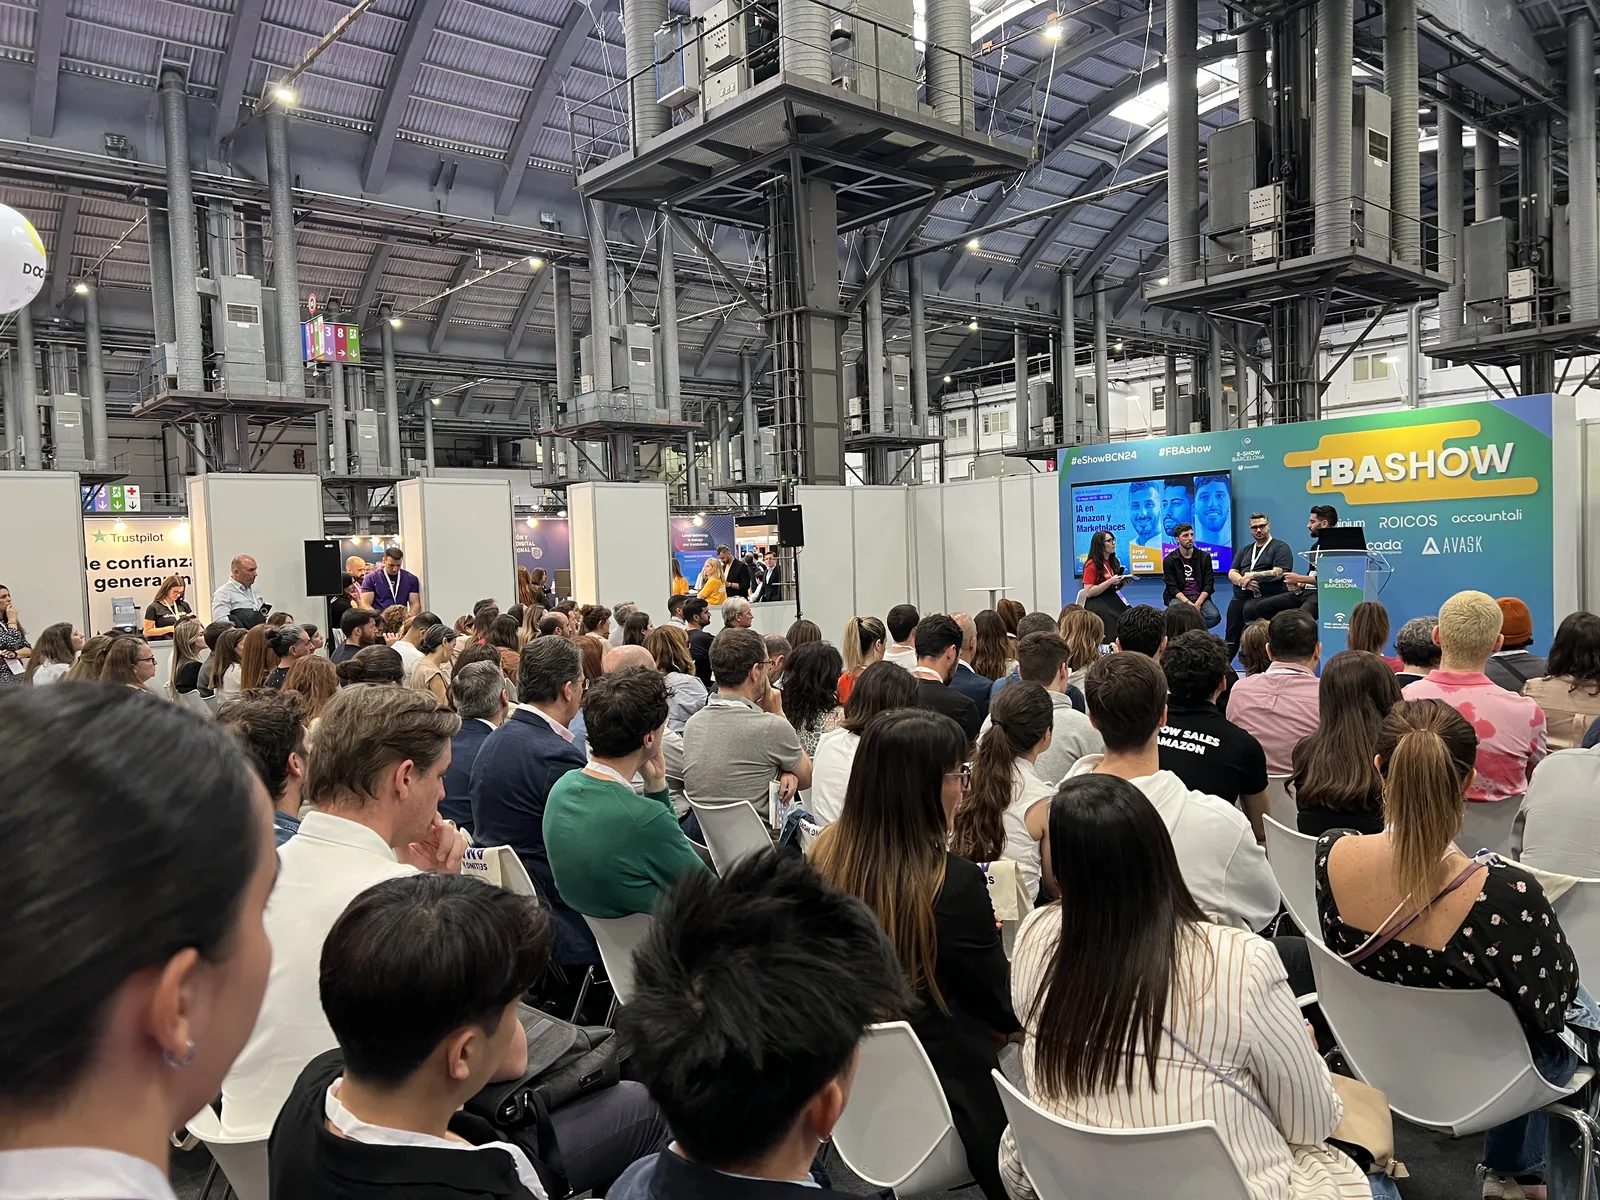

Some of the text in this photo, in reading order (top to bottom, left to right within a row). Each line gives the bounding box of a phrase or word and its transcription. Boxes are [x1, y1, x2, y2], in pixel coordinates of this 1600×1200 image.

[325, 327, 344, 338] 3 8
[1158, 444, 1212, 457] #FBAshow
[1071, 451, 1137, 466] #eShowBCN24
[1310, 442, 1515, 487] FBASHOW
[1076, 515, 1105, 523] Amazon
[1379, 514, 1438, 529] ROICOS
[1451, 509, 1522, 524] accountali
[110, 533, 164, 544] Trustpilot
[1443, 536, 1483, 553] AVASK
[94, 576, 166, 592] genera
[1160, 726, 1221, 747] OW SALES
